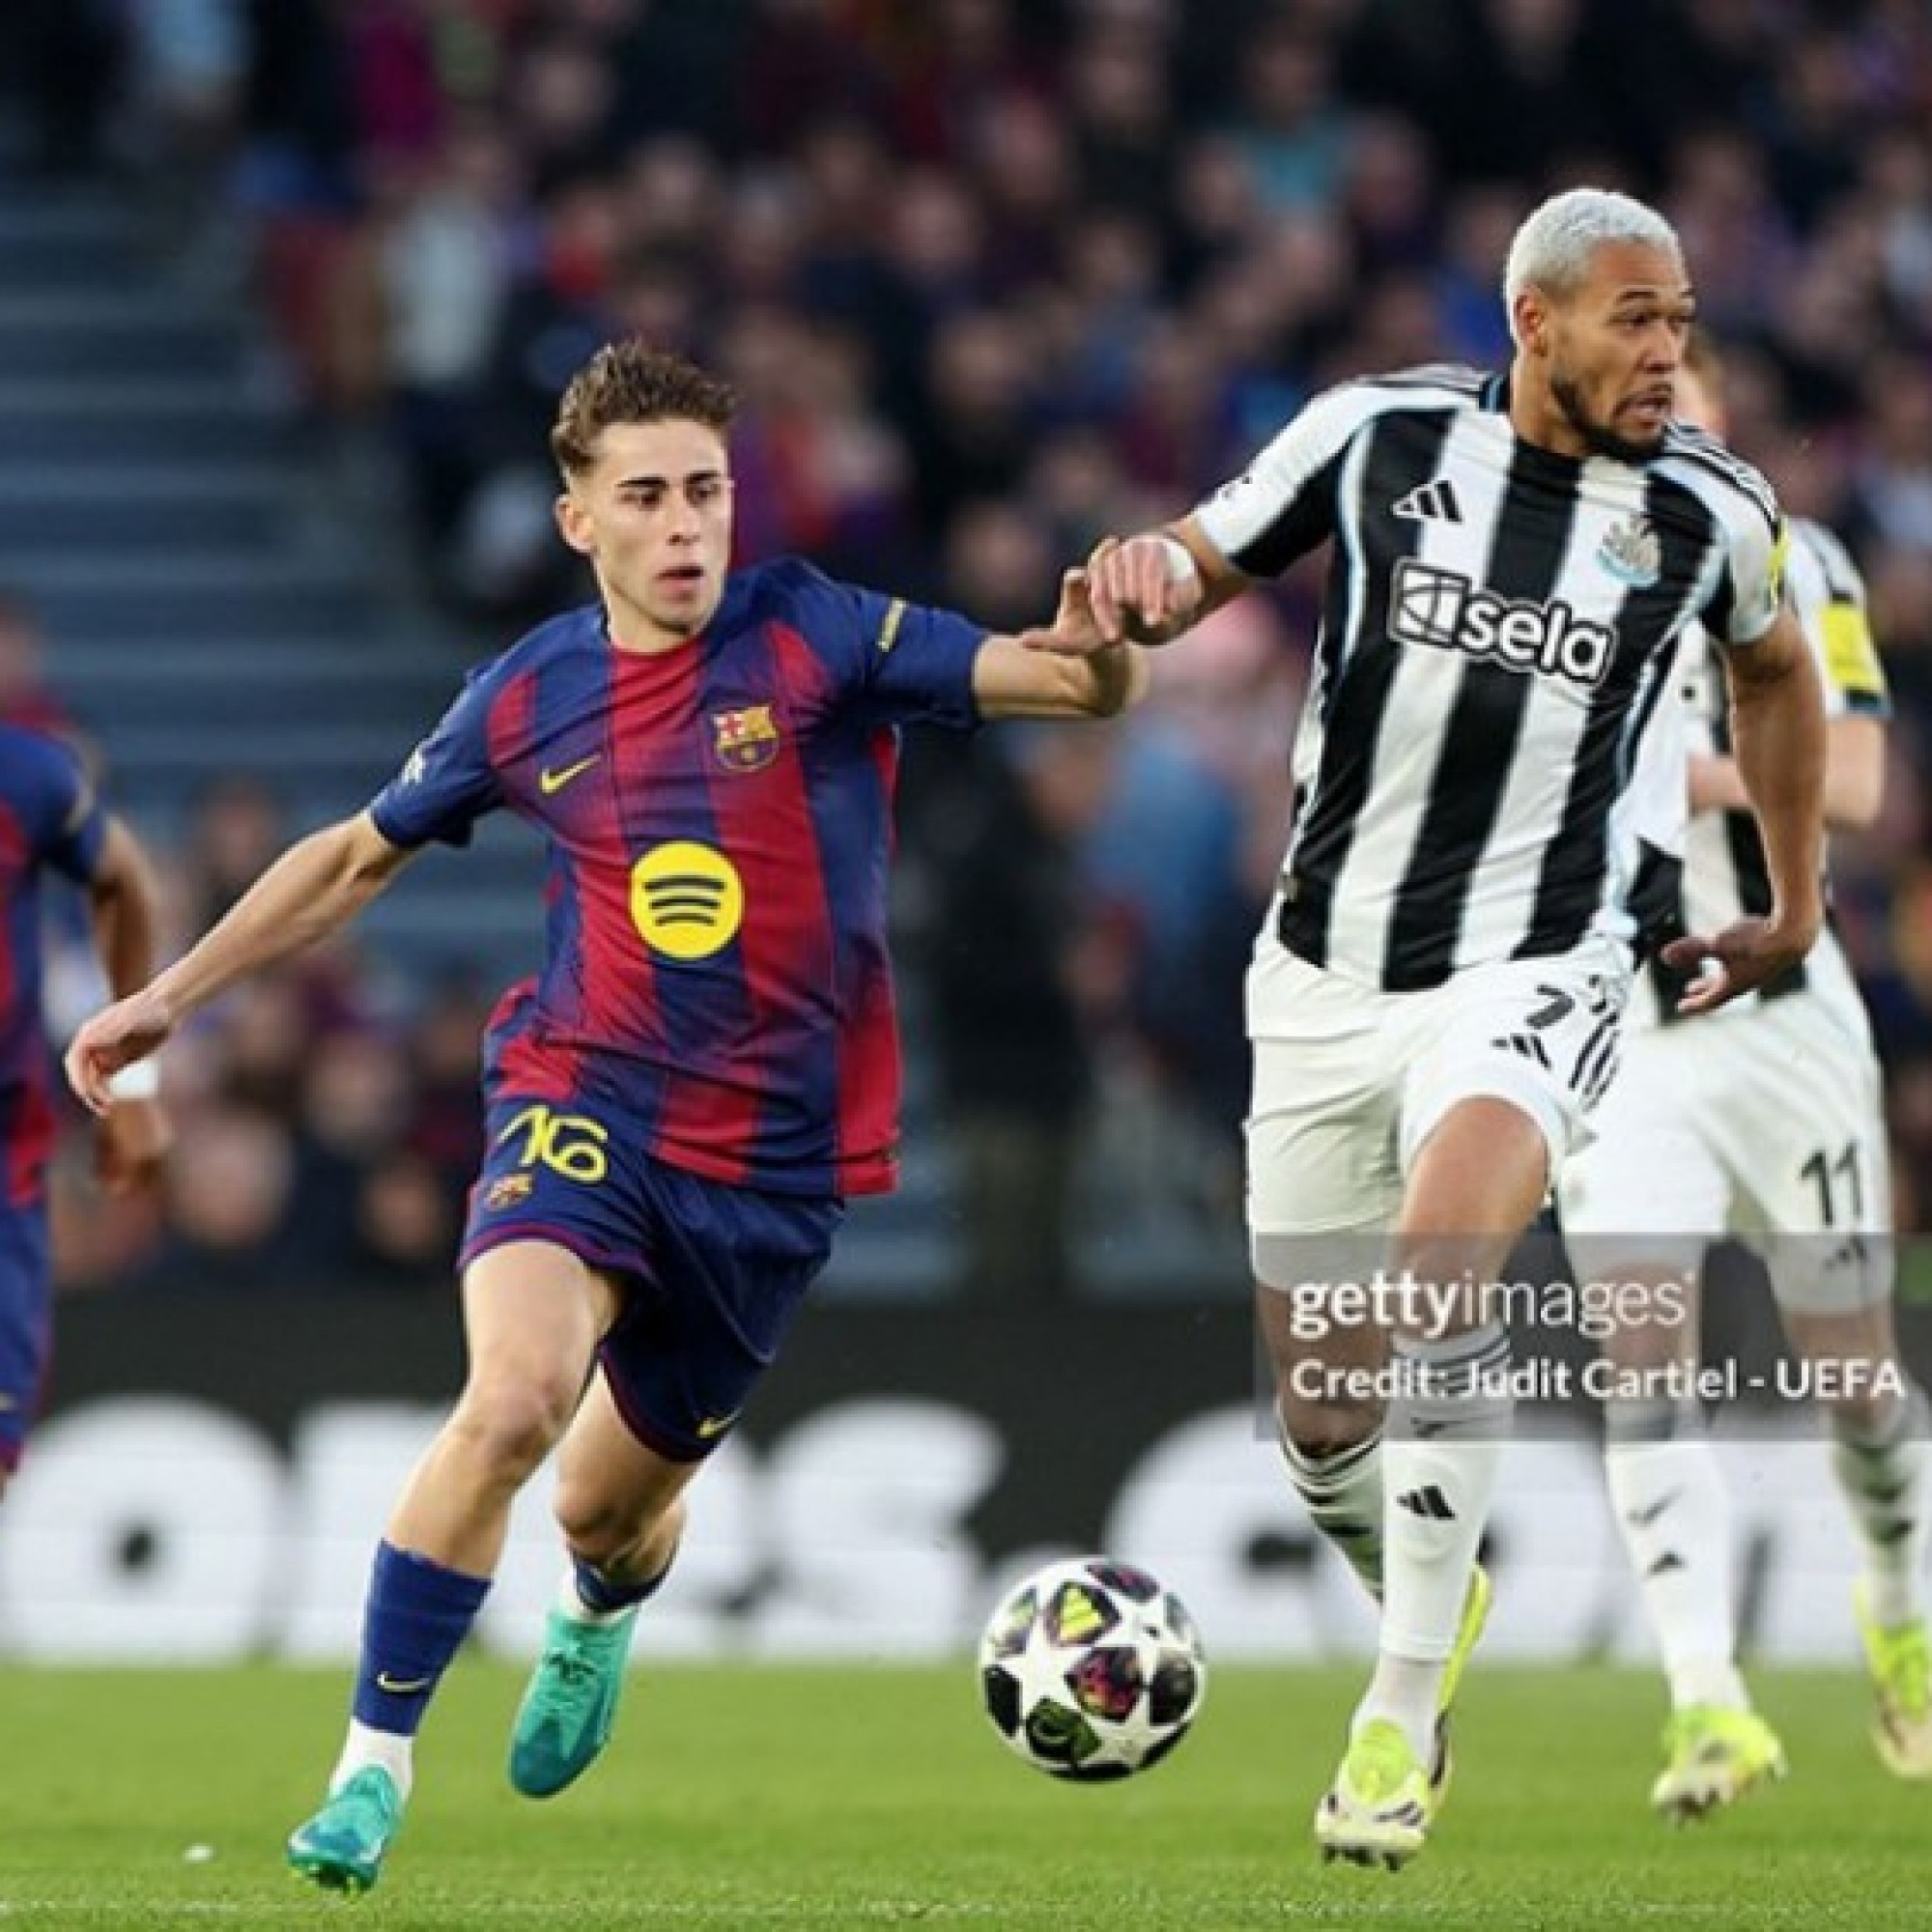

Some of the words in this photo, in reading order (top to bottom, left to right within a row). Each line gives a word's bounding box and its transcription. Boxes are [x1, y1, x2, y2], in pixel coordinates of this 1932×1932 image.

[1458, 598, 1609, 681] sela
[497, 1104, 609, 1181] 16
[1800, 1139, 1865, 1228] 11
